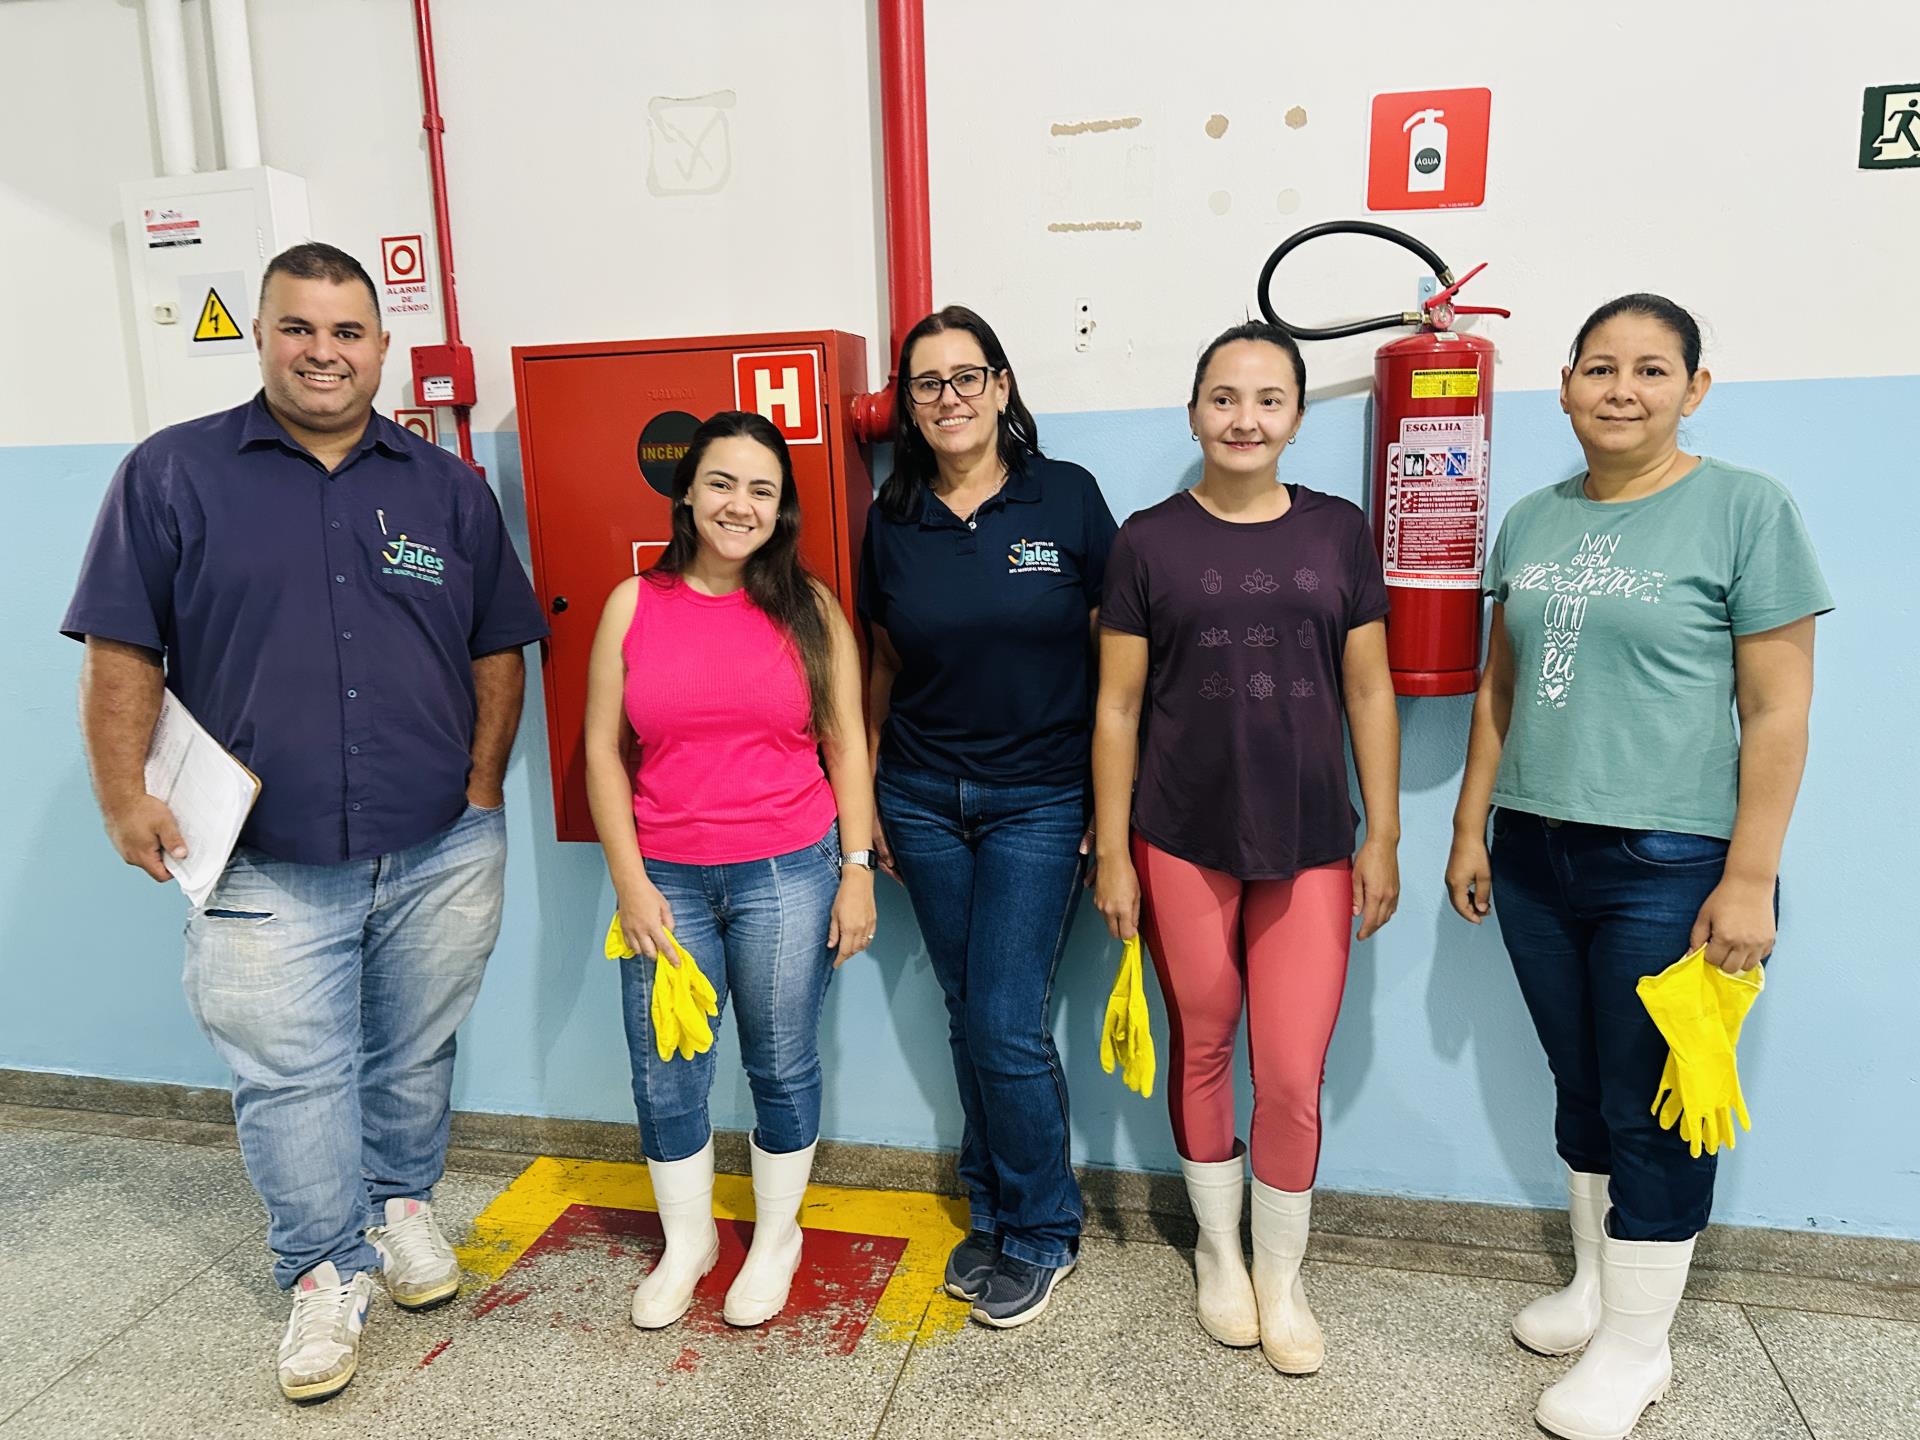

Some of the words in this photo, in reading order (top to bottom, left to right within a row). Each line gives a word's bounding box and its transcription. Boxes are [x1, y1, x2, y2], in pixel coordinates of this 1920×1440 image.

[386, 286, 427, 295] ALARME
[754, 367, 802, 428] H
[1405, 423, 1462, 432] ESGALHA
[1387, 453, 1400, 563] ESGALHA
[382, 534, 444, 571] Jales
[1007, 538, 1059, 567] Jales
[1579, 532, 1621, 554] NIN
[1571, 550, 1612, 568] GUÉM
[1544, 593, 1588, 631] COMO
[1542, 647, 1575, 681] eu
